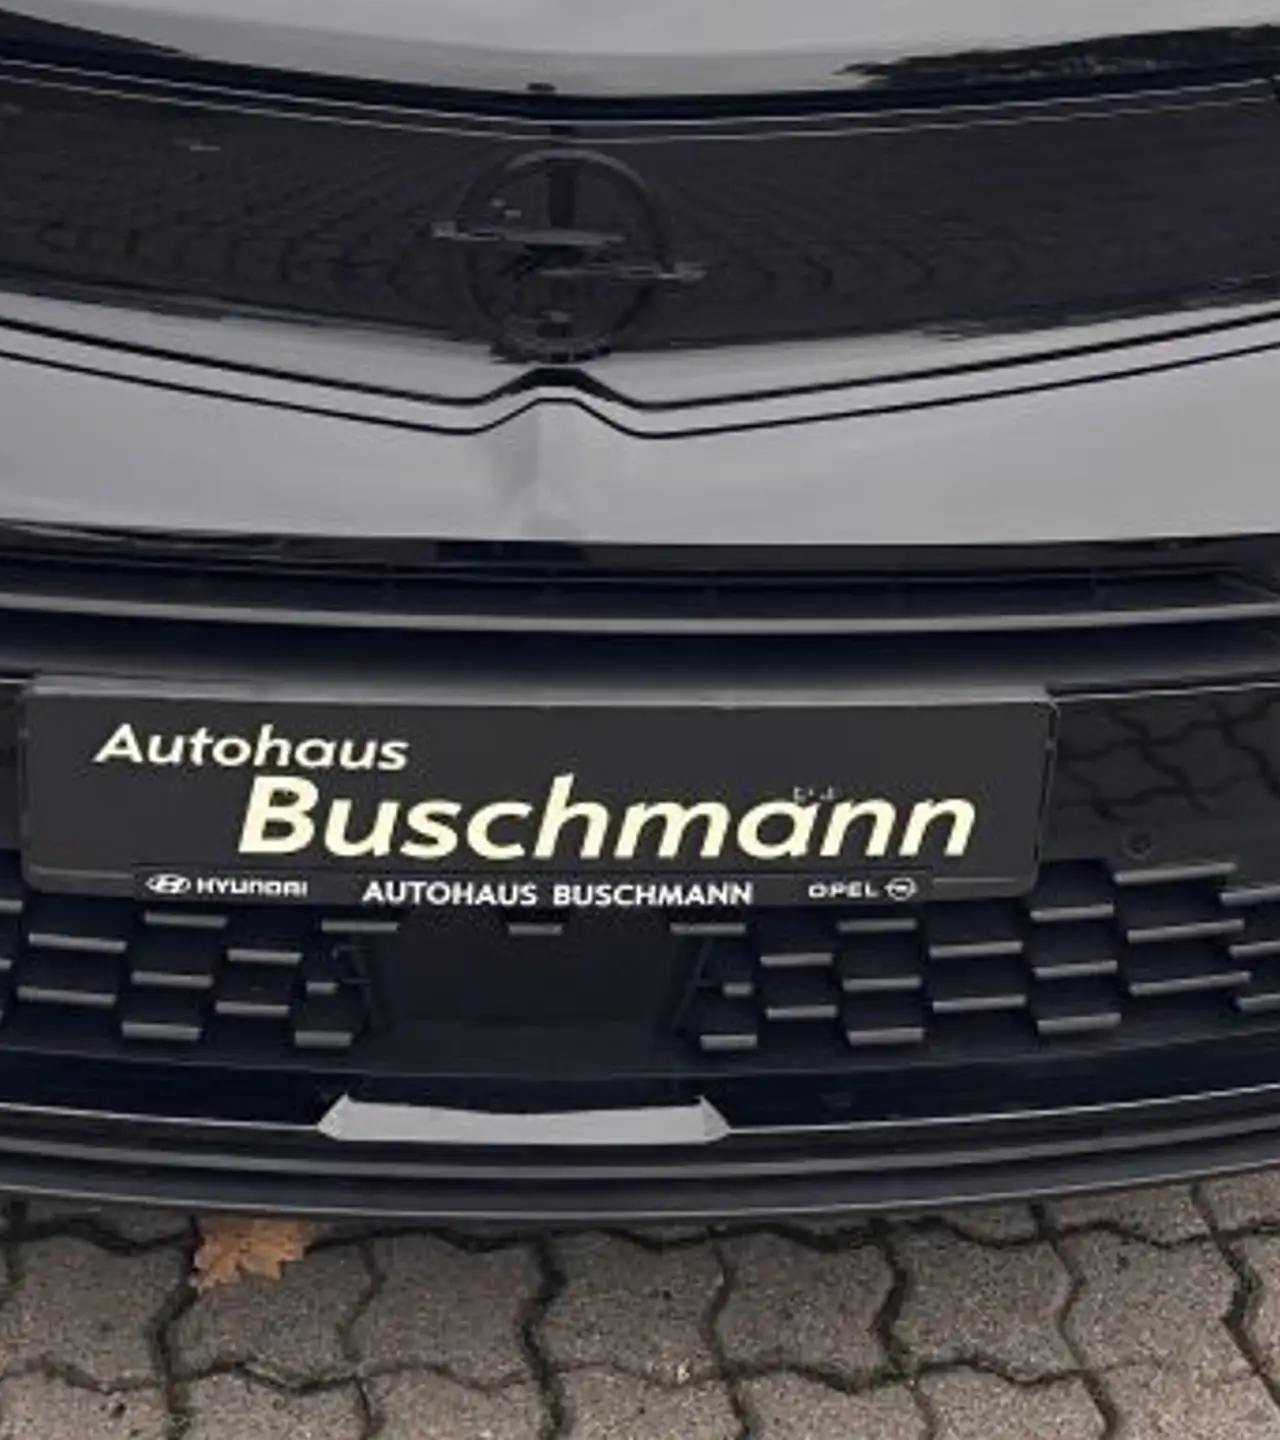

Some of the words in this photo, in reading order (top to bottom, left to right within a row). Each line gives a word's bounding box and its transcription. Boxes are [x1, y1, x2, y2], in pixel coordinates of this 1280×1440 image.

[94, 723, 410, 771] Autohaus
[238, 773, 976, 860] Buschmann
[196, 877, 308, 897] HYUNDAI
[362, 880, 538, 906] AUTOHAUS
[552, 882, 754, 906] BUSCHMANN
[807, 882, 879, 899] OPEL
